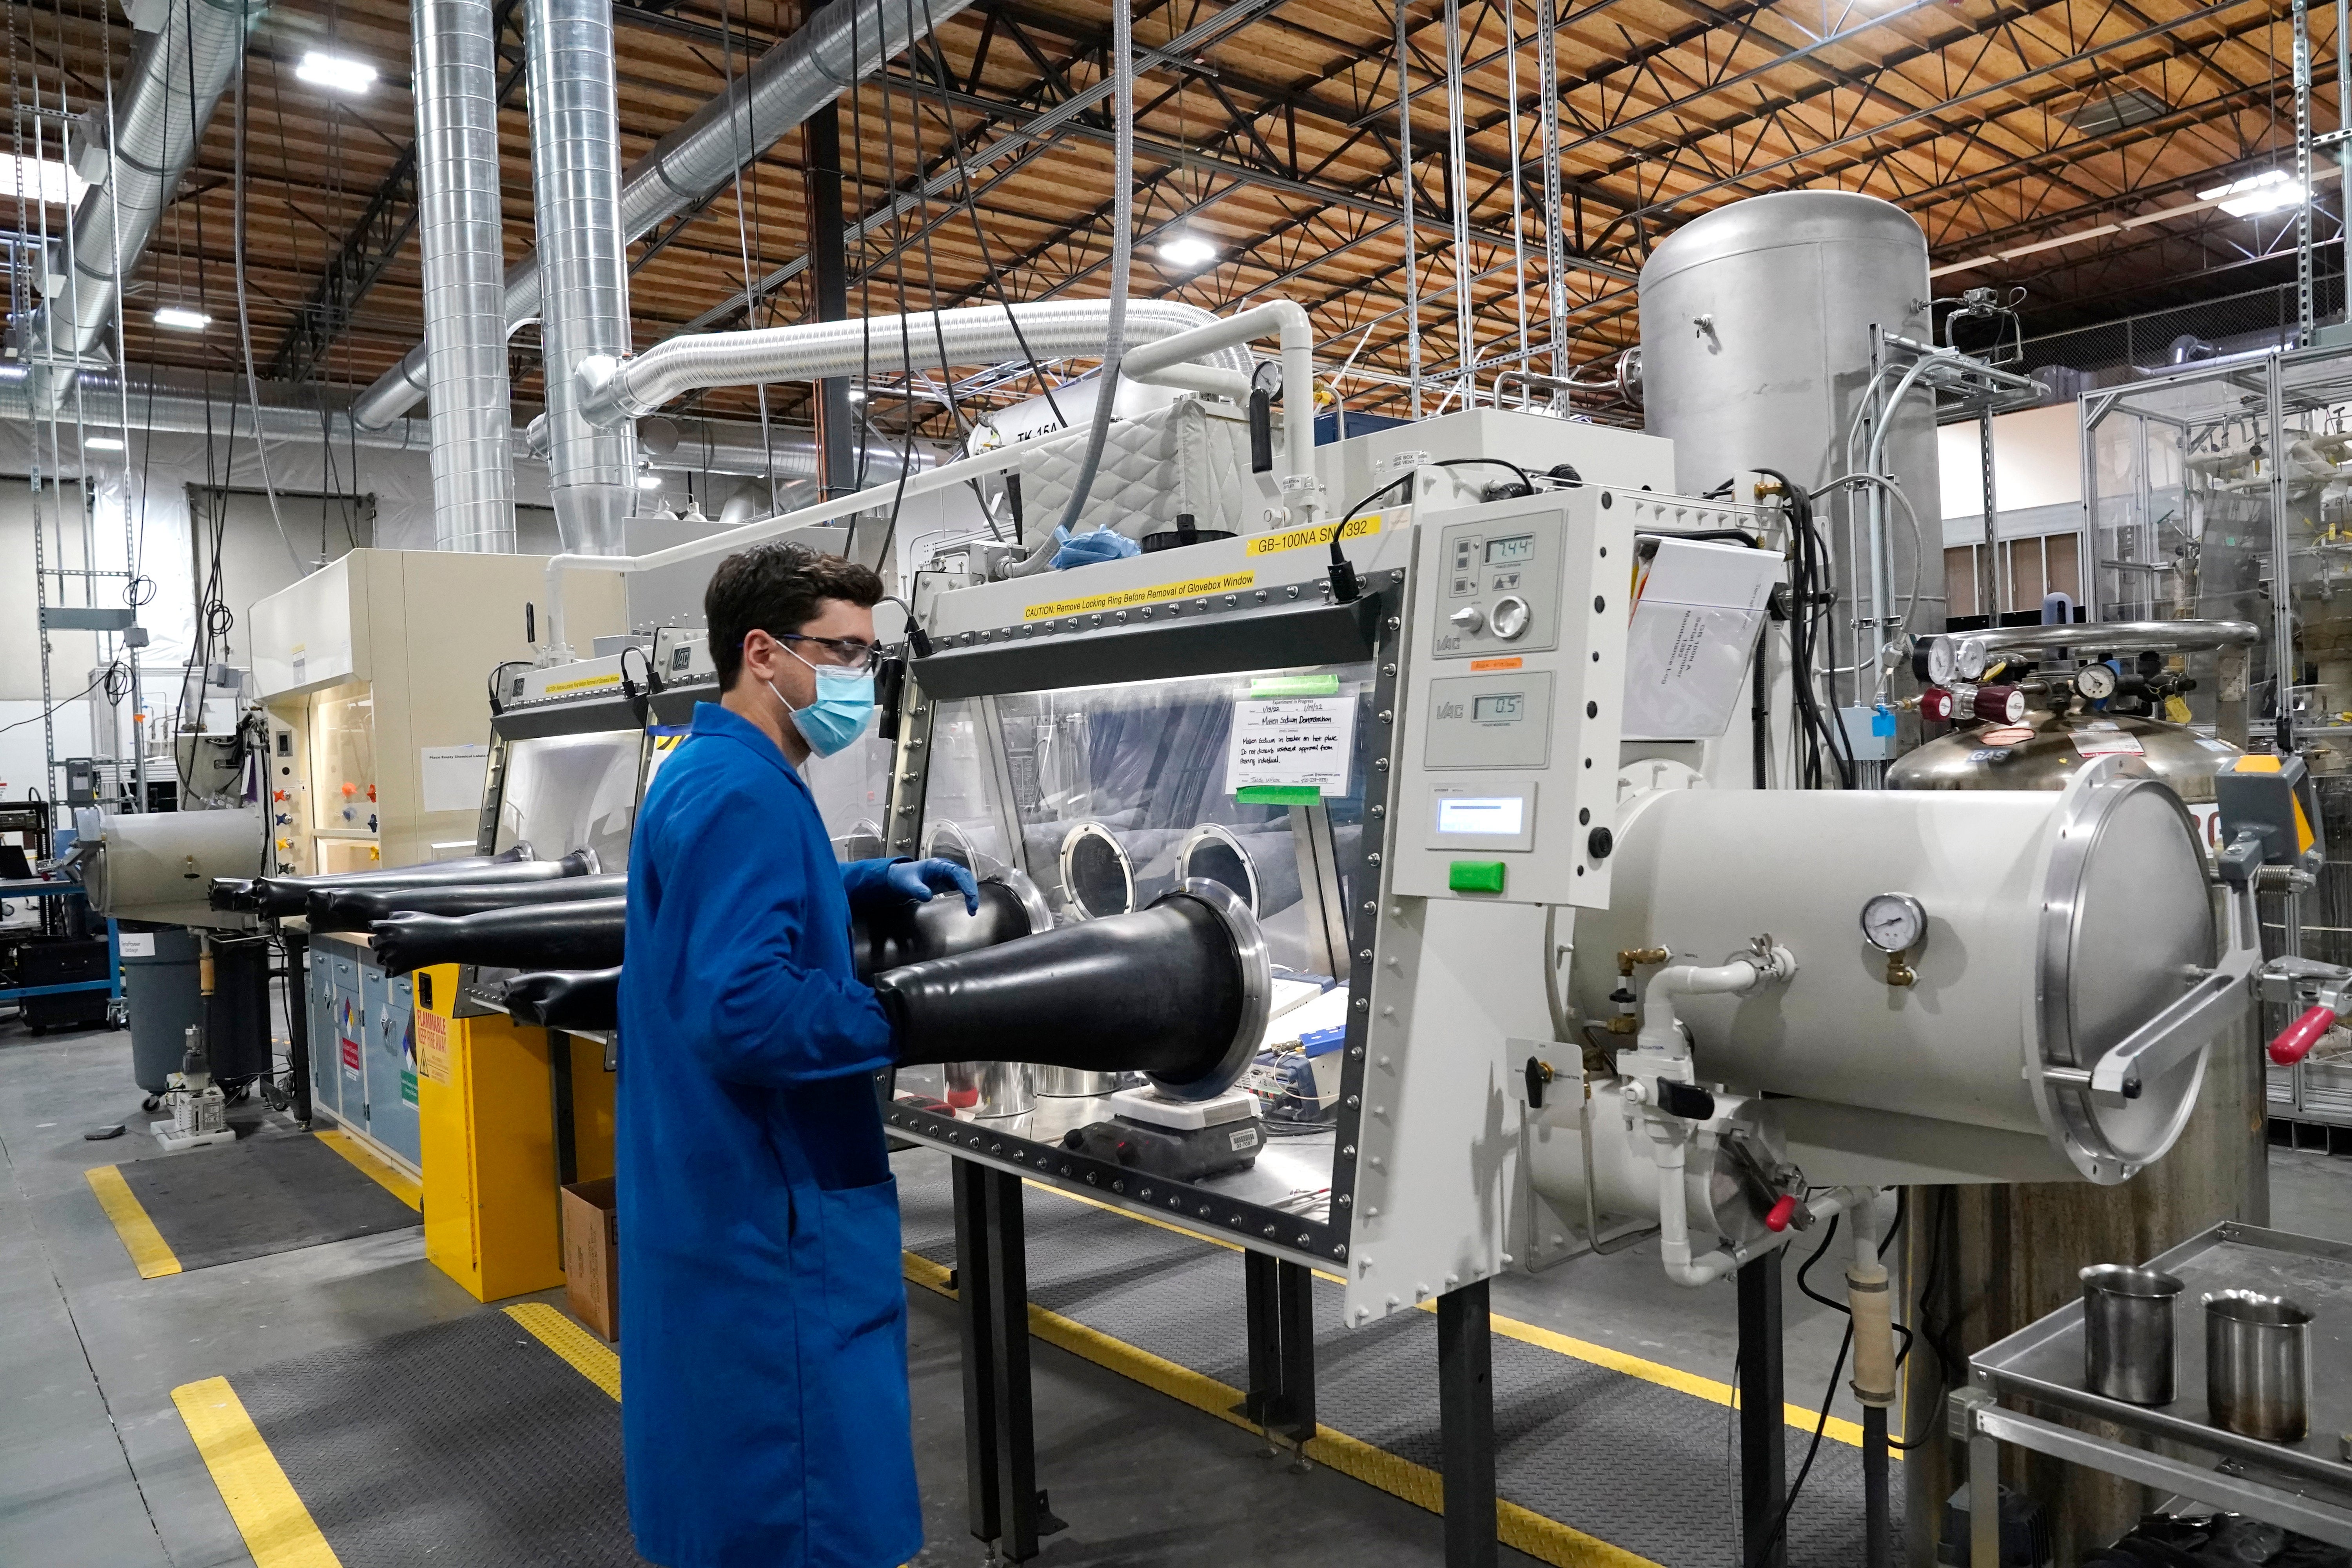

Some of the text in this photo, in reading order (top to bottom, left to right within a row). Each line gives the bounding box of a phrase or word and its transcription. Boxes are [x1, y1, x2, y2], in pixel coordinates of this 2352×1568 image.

[1259, 531, 1316, 553] GB-100NA
[1025, 575, 1253, 617] CAUTION: Remove Locking Ring Before Removal of Glovebox Window
[674, 649, 689, 668] VAC
[1661, 610, 1691, 684] Maintenance Log
[1677, 644, 1691, 678] Number
[1437, 701, 1464, 719] VAC
[1299, 745, 1318, 754] approval
[1971, 751, 2007, 761] GAS
[417, 1009, 446, 1036] FLAMMABLE
[418, 1026, 446, 1054] KEEP FIRE AWAY
